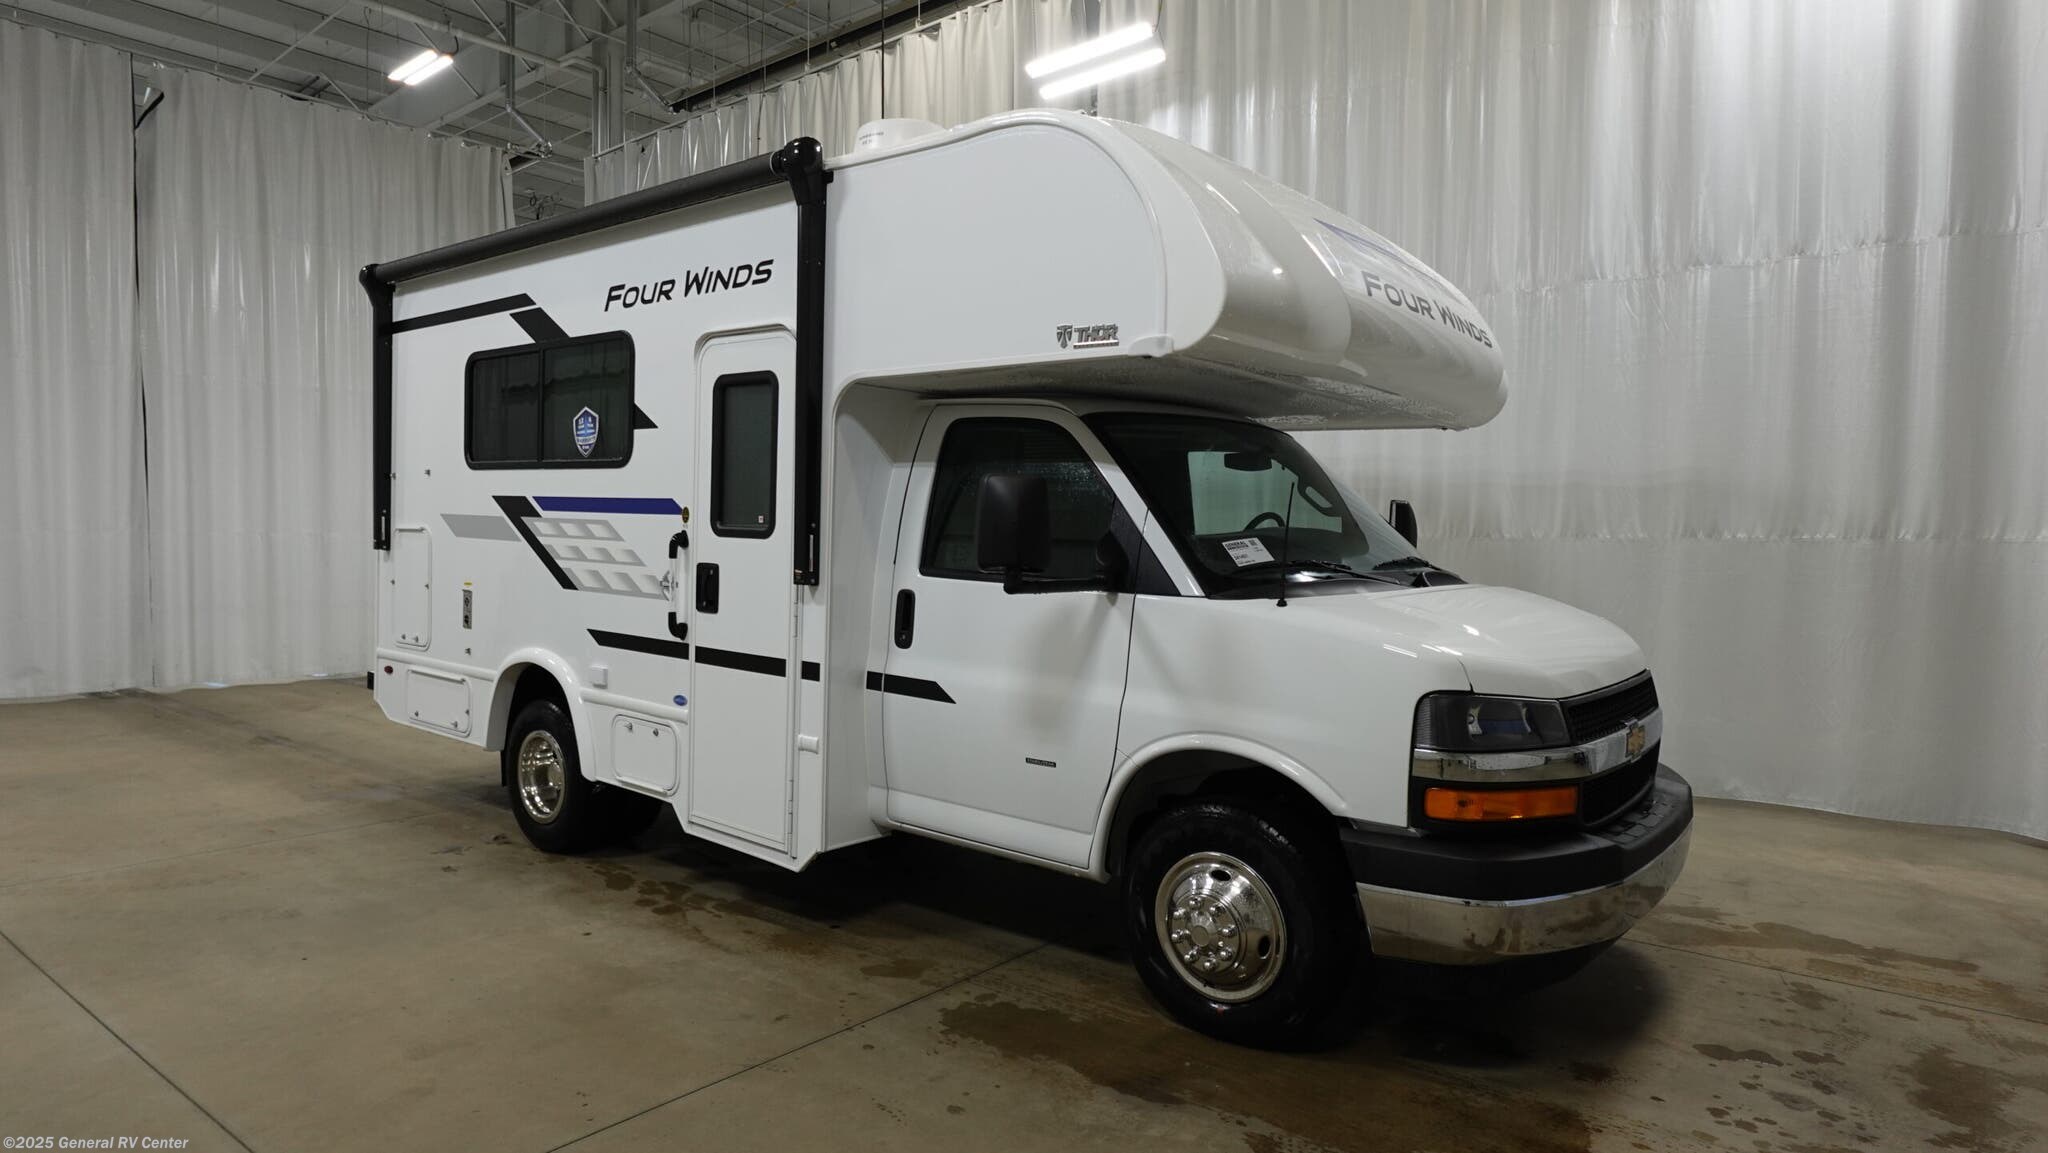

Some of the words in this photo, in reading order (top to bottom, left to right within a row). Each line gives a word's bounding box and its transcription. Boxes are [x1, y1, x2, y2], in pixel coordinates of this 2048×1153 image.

[604, 279, 676, 312] FOUR
[684, 259, 774, 298] WINDS
[1361, 270, 1436, 321] FOUR
[1433, 300, 1493, 349] WINDS
[1073, 324, 1119, 343] THOR
